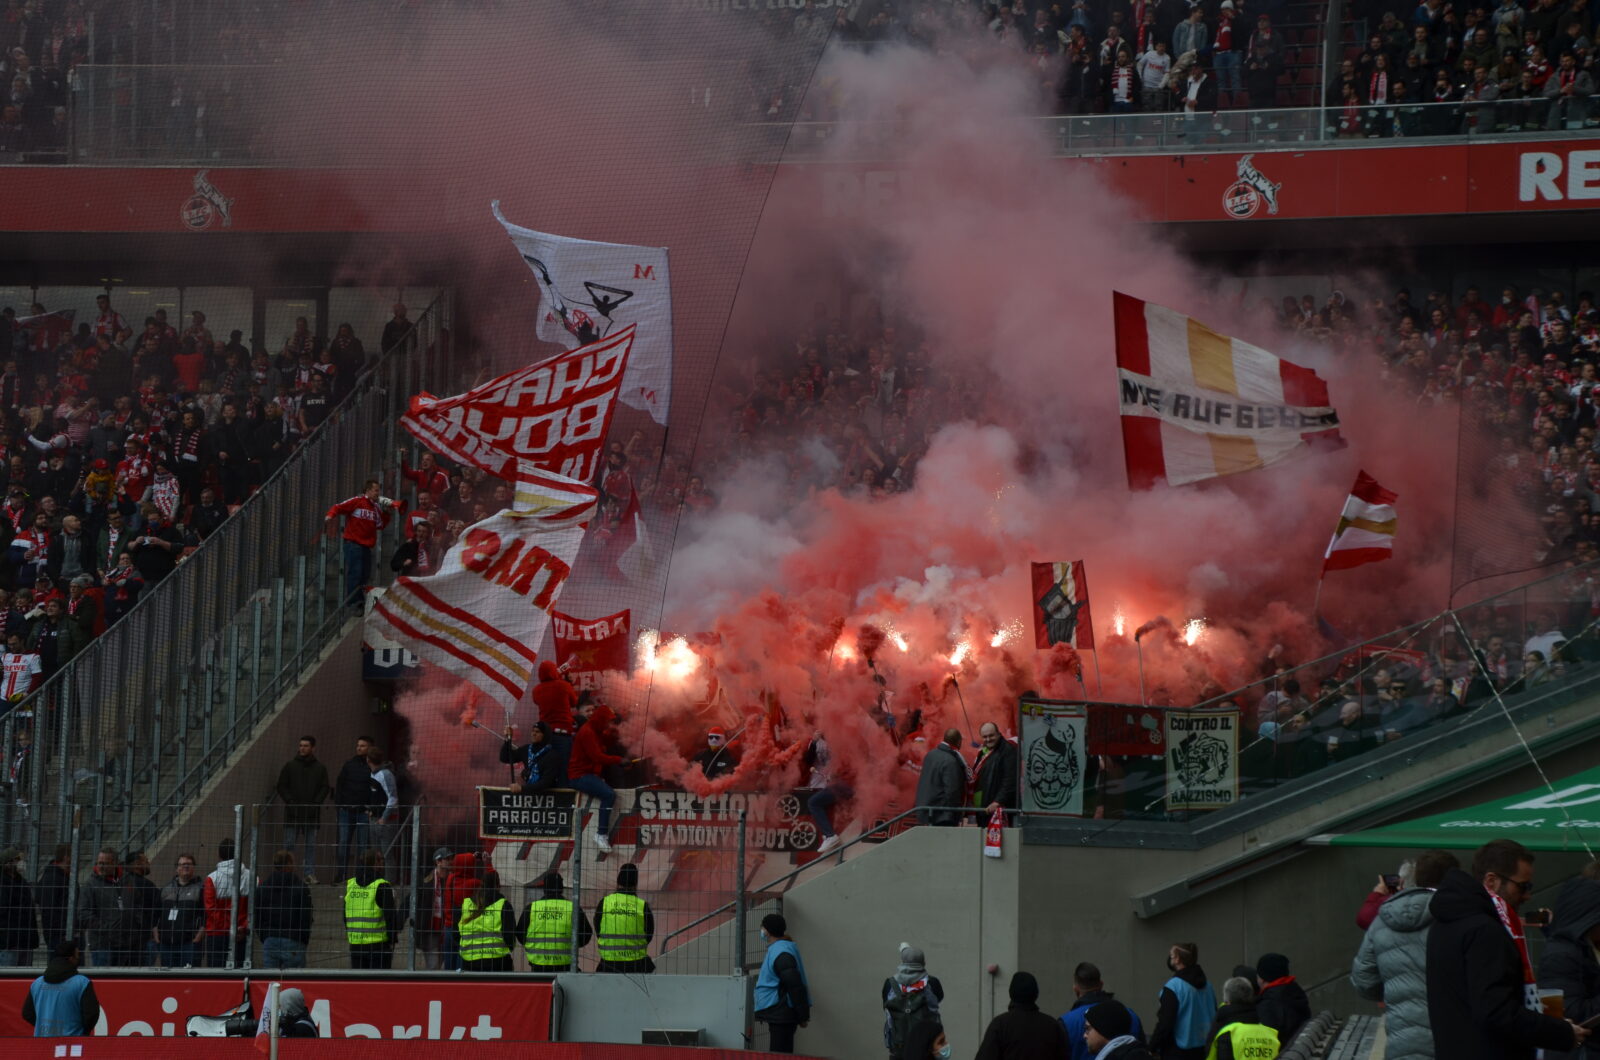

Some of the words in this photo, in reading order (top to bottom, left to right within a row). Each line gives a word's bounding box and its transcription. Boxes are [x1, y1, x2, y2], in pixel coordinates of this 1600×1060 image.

[554, 616, 627, 641] ULTRA
[1170, 717, 1217, 731] CONTRO
[1220, 717, 1232, 730] IL
[501, 794, 555, 808] CURVA
[1171, 790, 1231, 804] RAZZISMO
[639, 791, 766, 821] SEKTION
[488, 810, 568, 825] PARADISO
[537, 912, 563, 921] ORDNER
[1243, 1048, 1273, 1058] ORDNER
